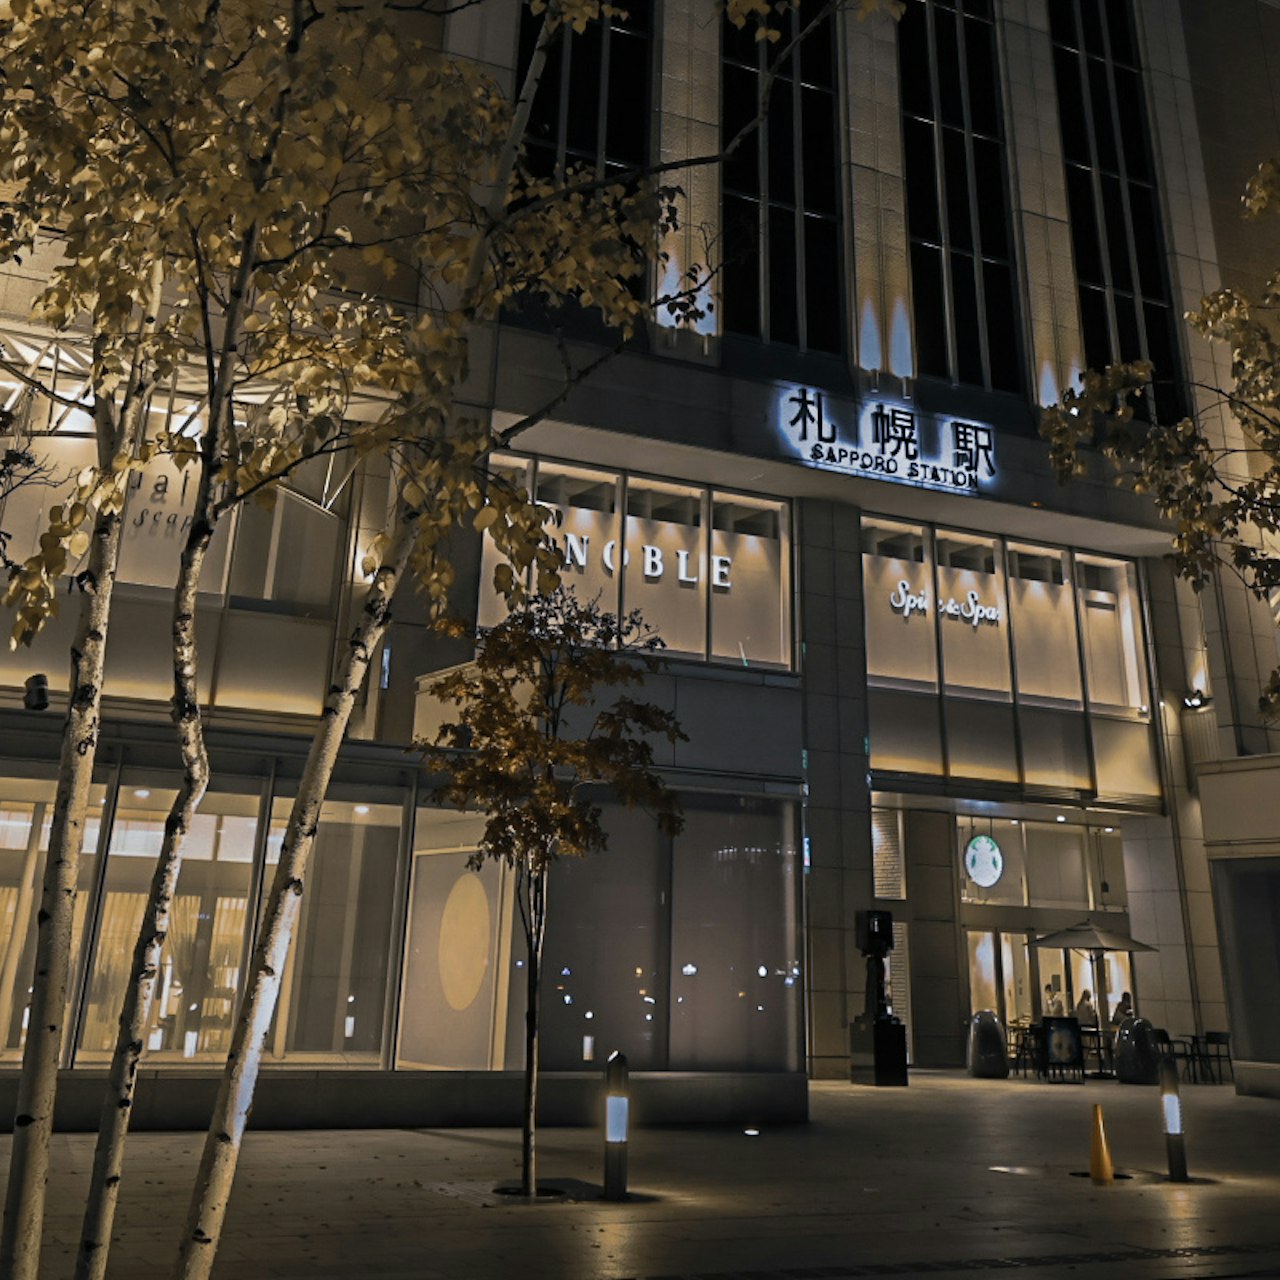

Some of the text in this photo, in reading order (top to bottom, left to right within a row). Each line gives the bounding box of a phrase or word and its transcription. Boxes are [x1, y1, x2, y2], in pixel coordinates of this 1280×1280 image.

[789, 388, 996, 477] 札幌駅
[810, 443, 979, 489] SAPPORO STATION
